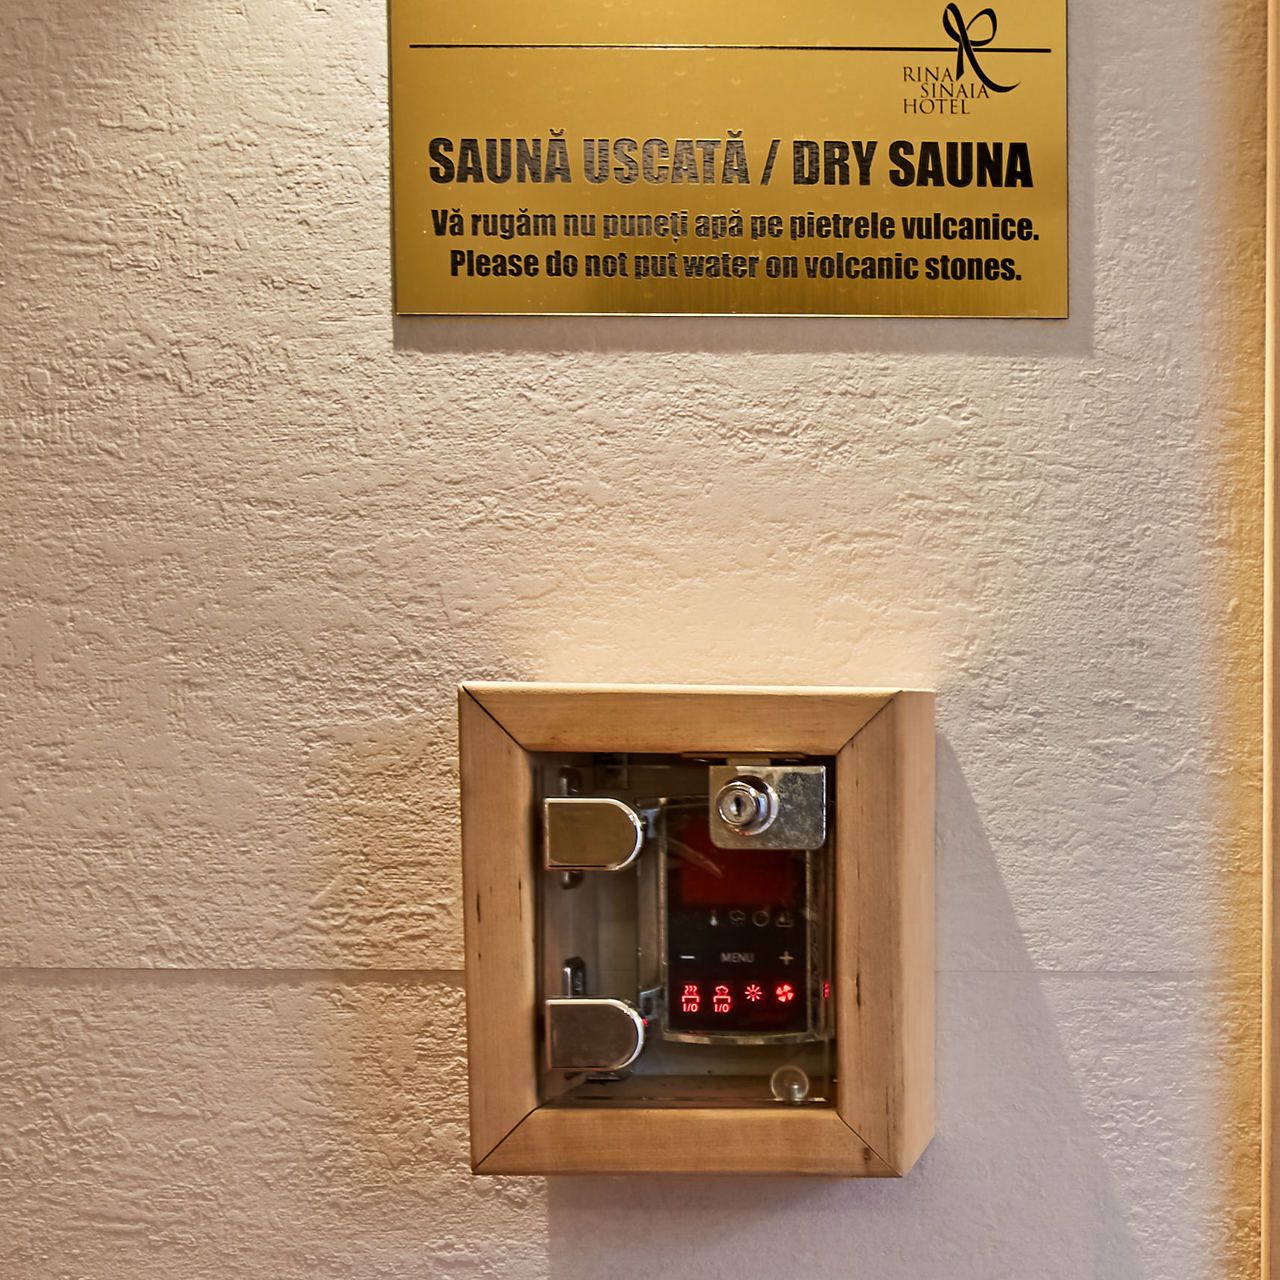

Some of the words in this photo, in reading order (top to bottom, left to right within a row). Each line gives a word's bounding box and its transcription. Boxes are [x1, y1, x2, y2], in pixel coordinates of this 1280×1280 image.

[903, 67, 954, 82] RINA
[921, 83, 990, 99] SINAIA
[903, 99, 970, 115] HOTEL
[428, 129, 572, 184] SAUNĂ
[583, 129, 750, 185] USCATĂ
[793, 140, 878, 186] DRY
[889, 141, 1034, 188] SAUNA
[431, 208, 464, 237] Vă
[471, 208, 556, 240] rugăm
[563, 213, 596, 237] nu
[695, 210, 742, 240] apă
[750, 215, 783, 241] pe
[790, 212, 896, 241] pietrele
[902, 213, 1039, 241] vulcanice.
[450, 250, 539, 277] Please
[546, 250, 578, 277] do
[585, 252, 628, 278] not
[635, 252, 678, 280] put
[683, 253, 759, 280] water
[766, 255, 798, 279] on
[804, 252, 919, 280] volcanic
[925, 255, 1022, 281] stones.
[720, 952, 754, 963] MENU
